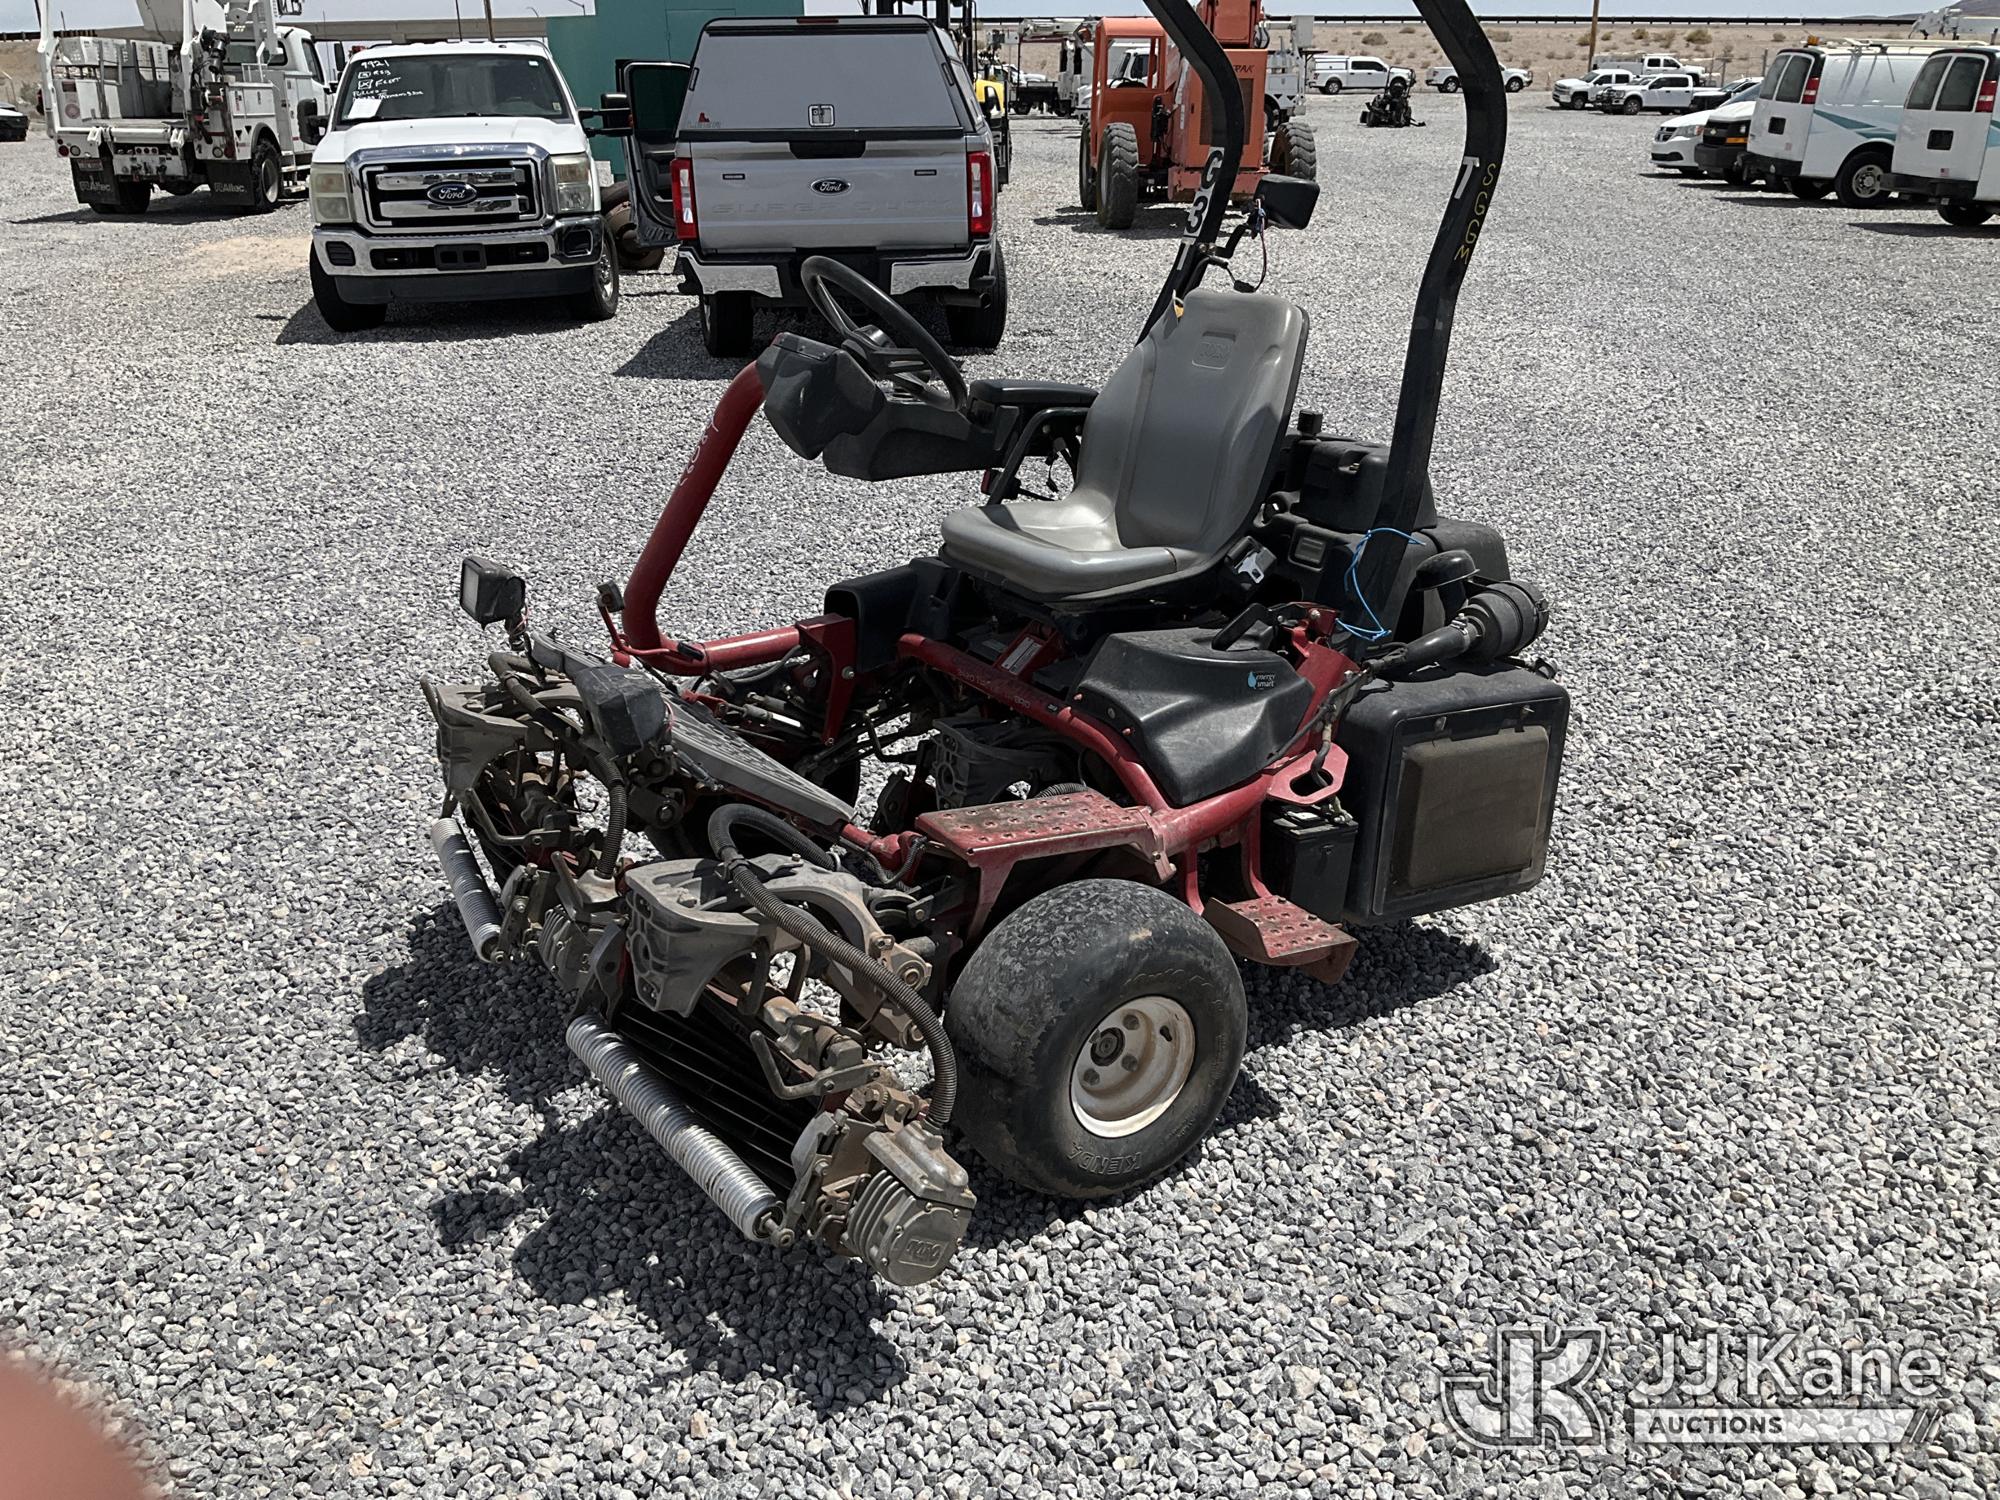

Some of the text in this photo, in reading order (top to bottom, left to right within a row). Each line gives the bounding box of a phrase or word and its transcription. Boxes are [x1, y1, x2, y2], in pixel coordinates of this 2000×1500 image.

[438, 187, 466, 200] Ford
[819, 181, 842, 193] Ford
[1067, 1141, 1141, 1175] KENDA
